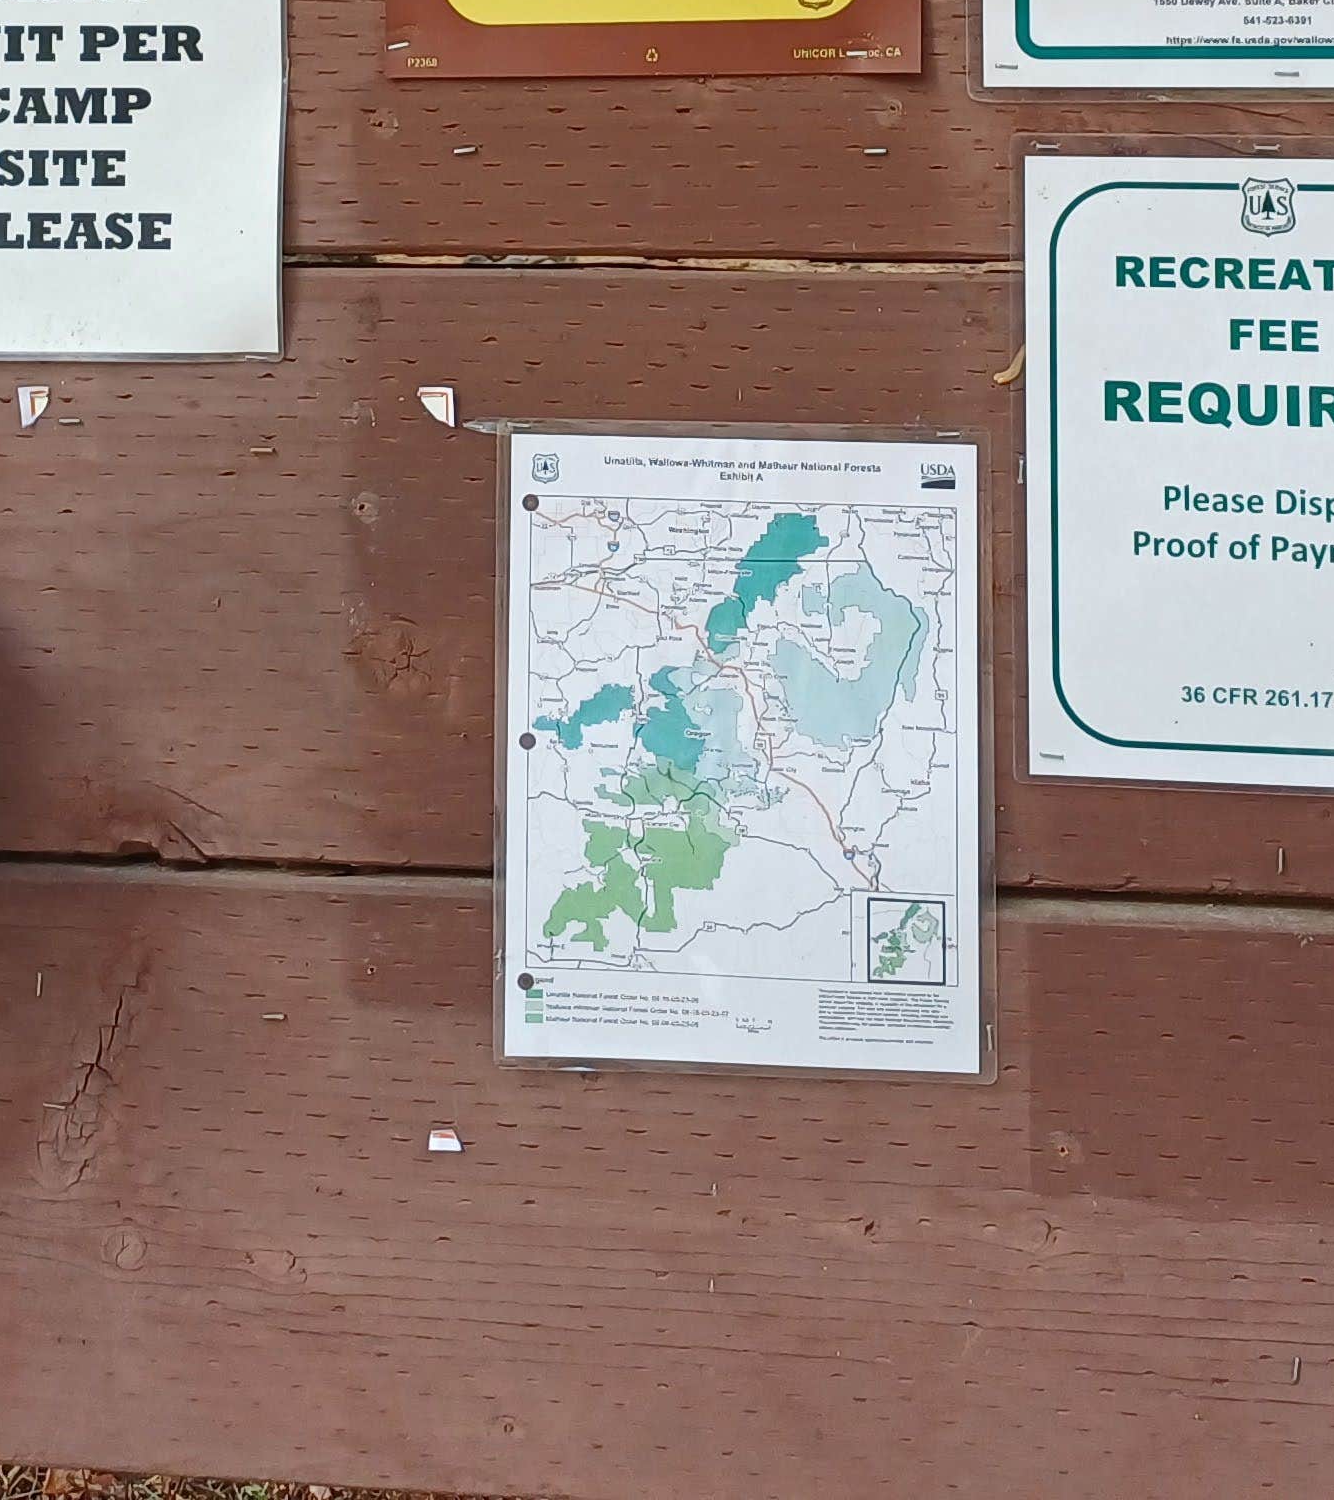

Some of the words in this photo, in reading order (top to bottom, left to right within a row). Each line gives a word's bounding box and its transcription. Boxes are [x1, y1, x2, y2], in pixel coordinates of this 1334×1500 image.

[80, 25, 203, 61] PER
[1230, 319, 1319, 352] FEE
[604, 456, 646, 467] Umatilla,
[648, 458, 735, 468] Wallowa-Whitman
[738, 461, 755, 469] and
[759, 461, 798, 470] Malheur
[801, 462, 841, 471] National
[844, 463, 881, 472] Forests
[920, 463, 956, 477] USDA
[720, 472, 753, 482] Exhibit
[756, 473, 763, 481] A
[1165, 485, 1263, 513] Please
[1134, 531, 1219, 558] Proof
[1229, 534, 1260, 560] of
[1182, 686, 1205, 703] 36
[1213, 687, 1257, 705] CFR
